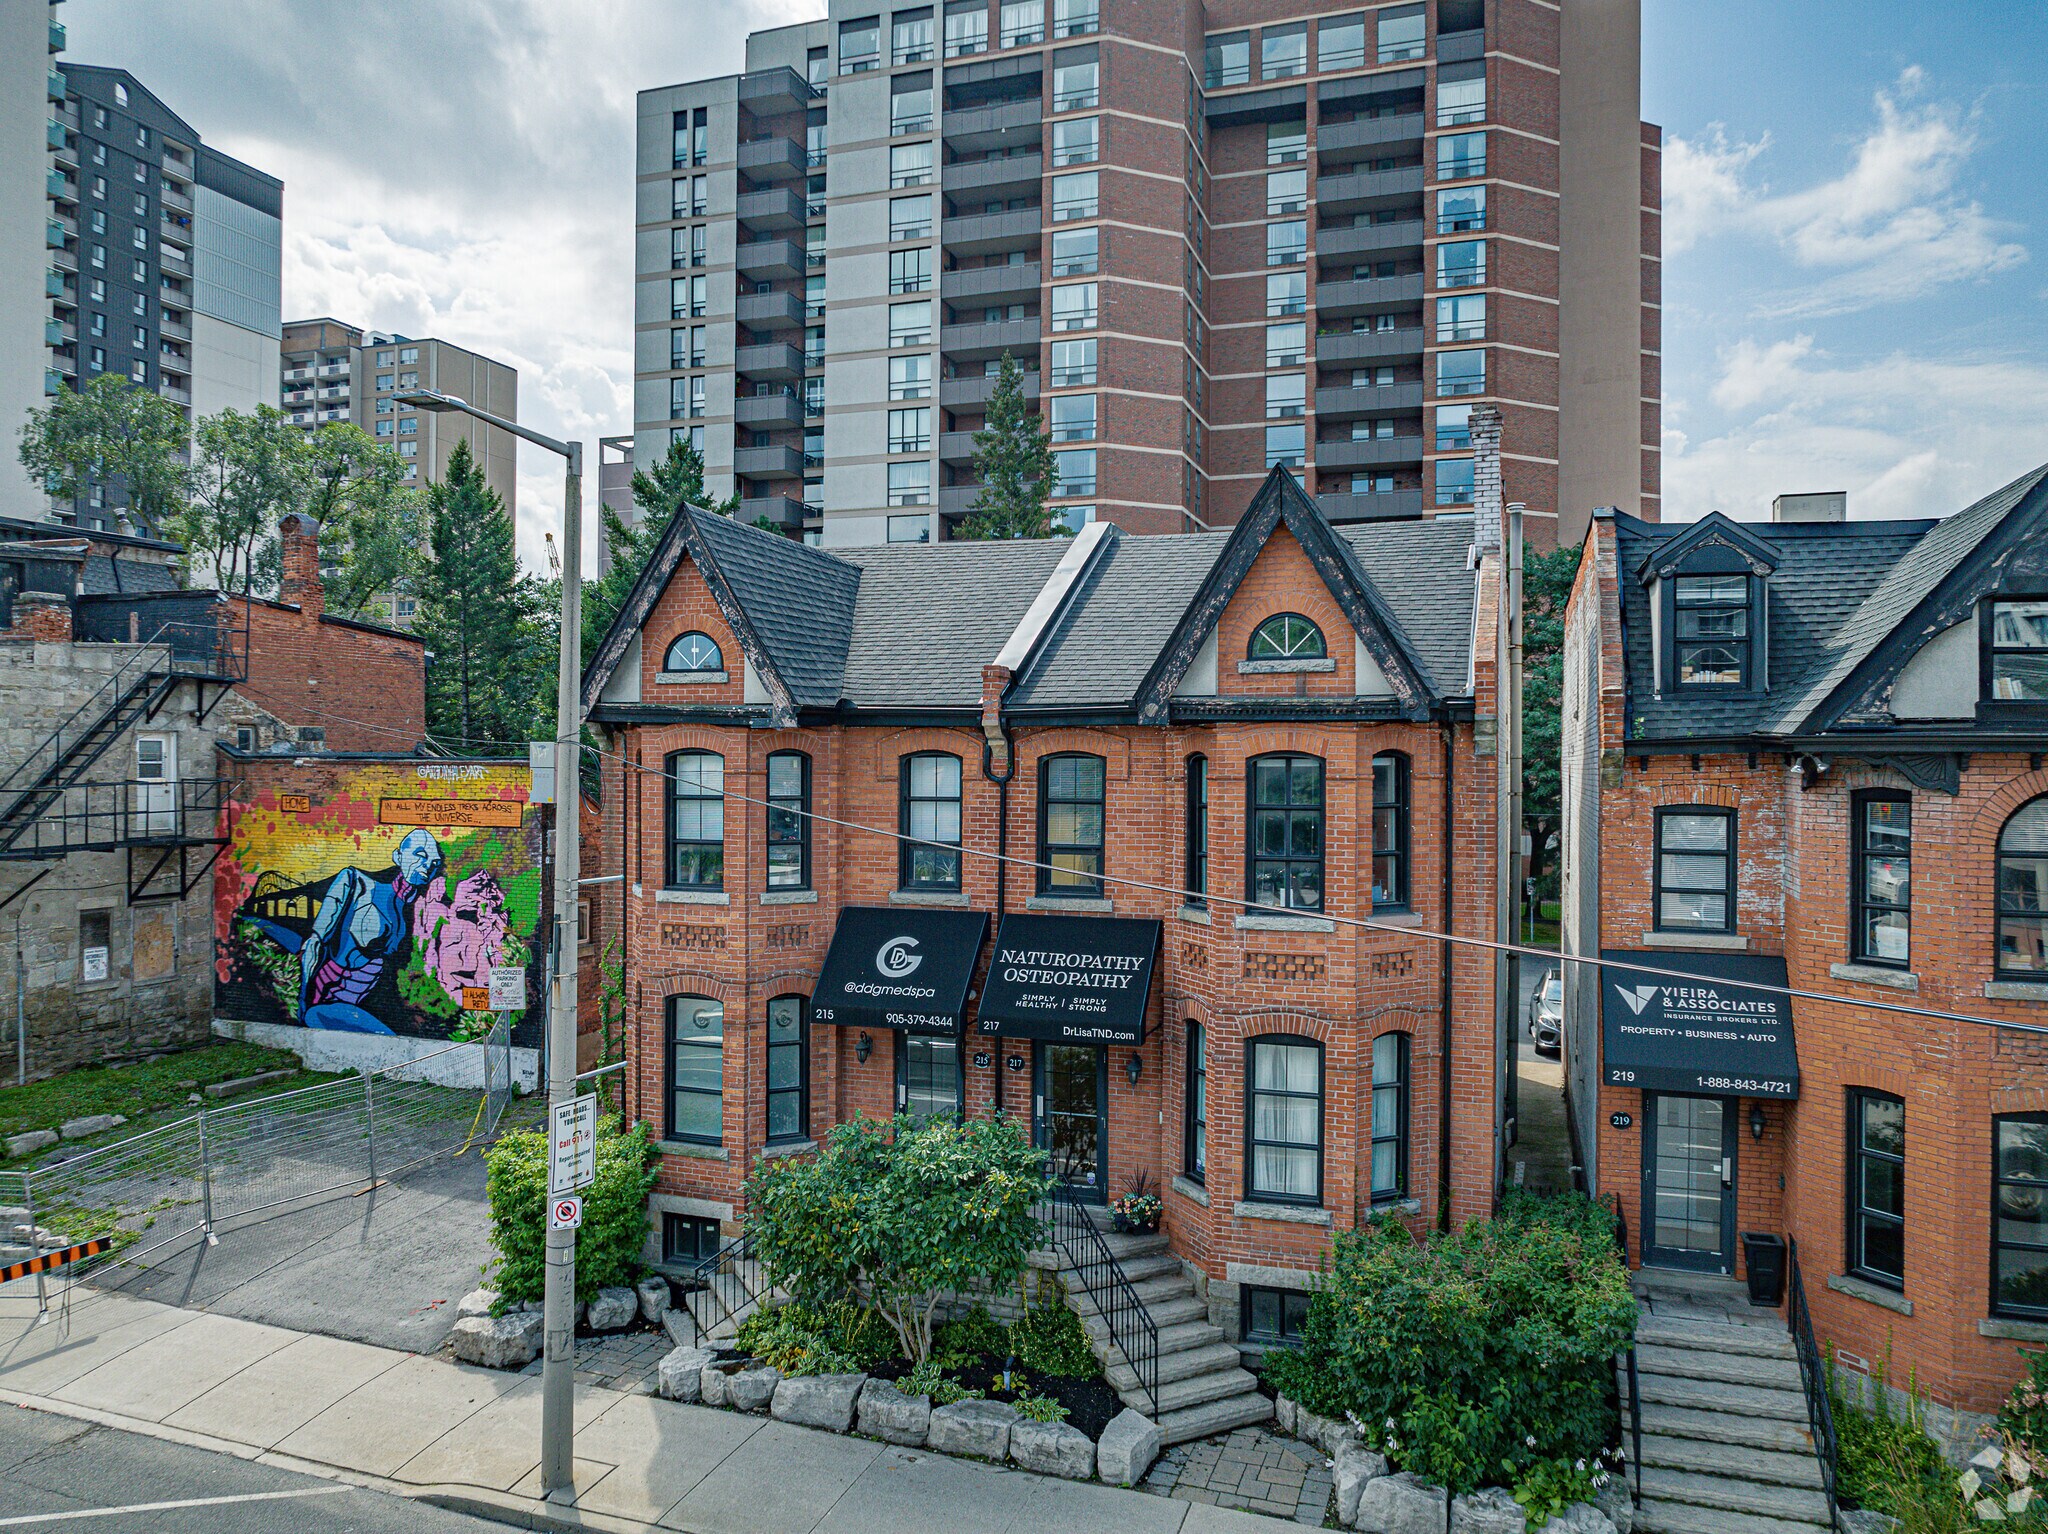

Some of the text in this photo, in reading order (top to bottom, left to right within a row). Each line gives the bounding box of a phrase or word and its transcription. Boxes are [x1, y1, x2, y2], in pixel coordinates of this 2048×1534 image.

[285, 797, 307, 810] HOME
[396, 803, 411, 811] ALL
[415, 803, 425, 811] MY
[426, 803, 456, 812] ENDLESS
[459, 803, 479, 811] TREKS
[482, 804, 513, 813] ACROSS
[416, 813, 430, 822] THE
[999, 949, 1145, 971] NATUROPATHY
[1003, 967, 1132, 989] OSTEOPATHY
[844, 981, 936, 999] @ddgmedspa
[1661, 986, 1719, 999] VIEIRA
[1021, 993, 1107, 1005] SIMPLY SIMPLY
[1663, 997, 1776, 1013] & ASSOCIATES
[1015, 1000, 1107, 1013] HEALTHY STRONG
[815, 1008, 953, 1027] 215 905-379-4344
[1663, 1013, 1713, 1022] INSURANCE
[1716, 1017, 1758, 1025] BROKERS
[983, 1021, 1135, 1041] 217 DrLisaTND.com
[1620, 1025, 1777, 1043] PROPERTY BUSINESS AUTO
[975, 1055, 989, 1065] 215
[1009, 1057, 1023, 1068] 217
[1612, 1070, 1791, 1094] 219 1-888-843-4721
[559, 1109, 571, 1119] SAFE
[563, 1113, 587, 1127] YOUR CALL
[1613, 1116, 1630, 1126] 219
[559, 1134, 583, 1149] Call 911
[558, 1147, 591, 1164] Report impaired
